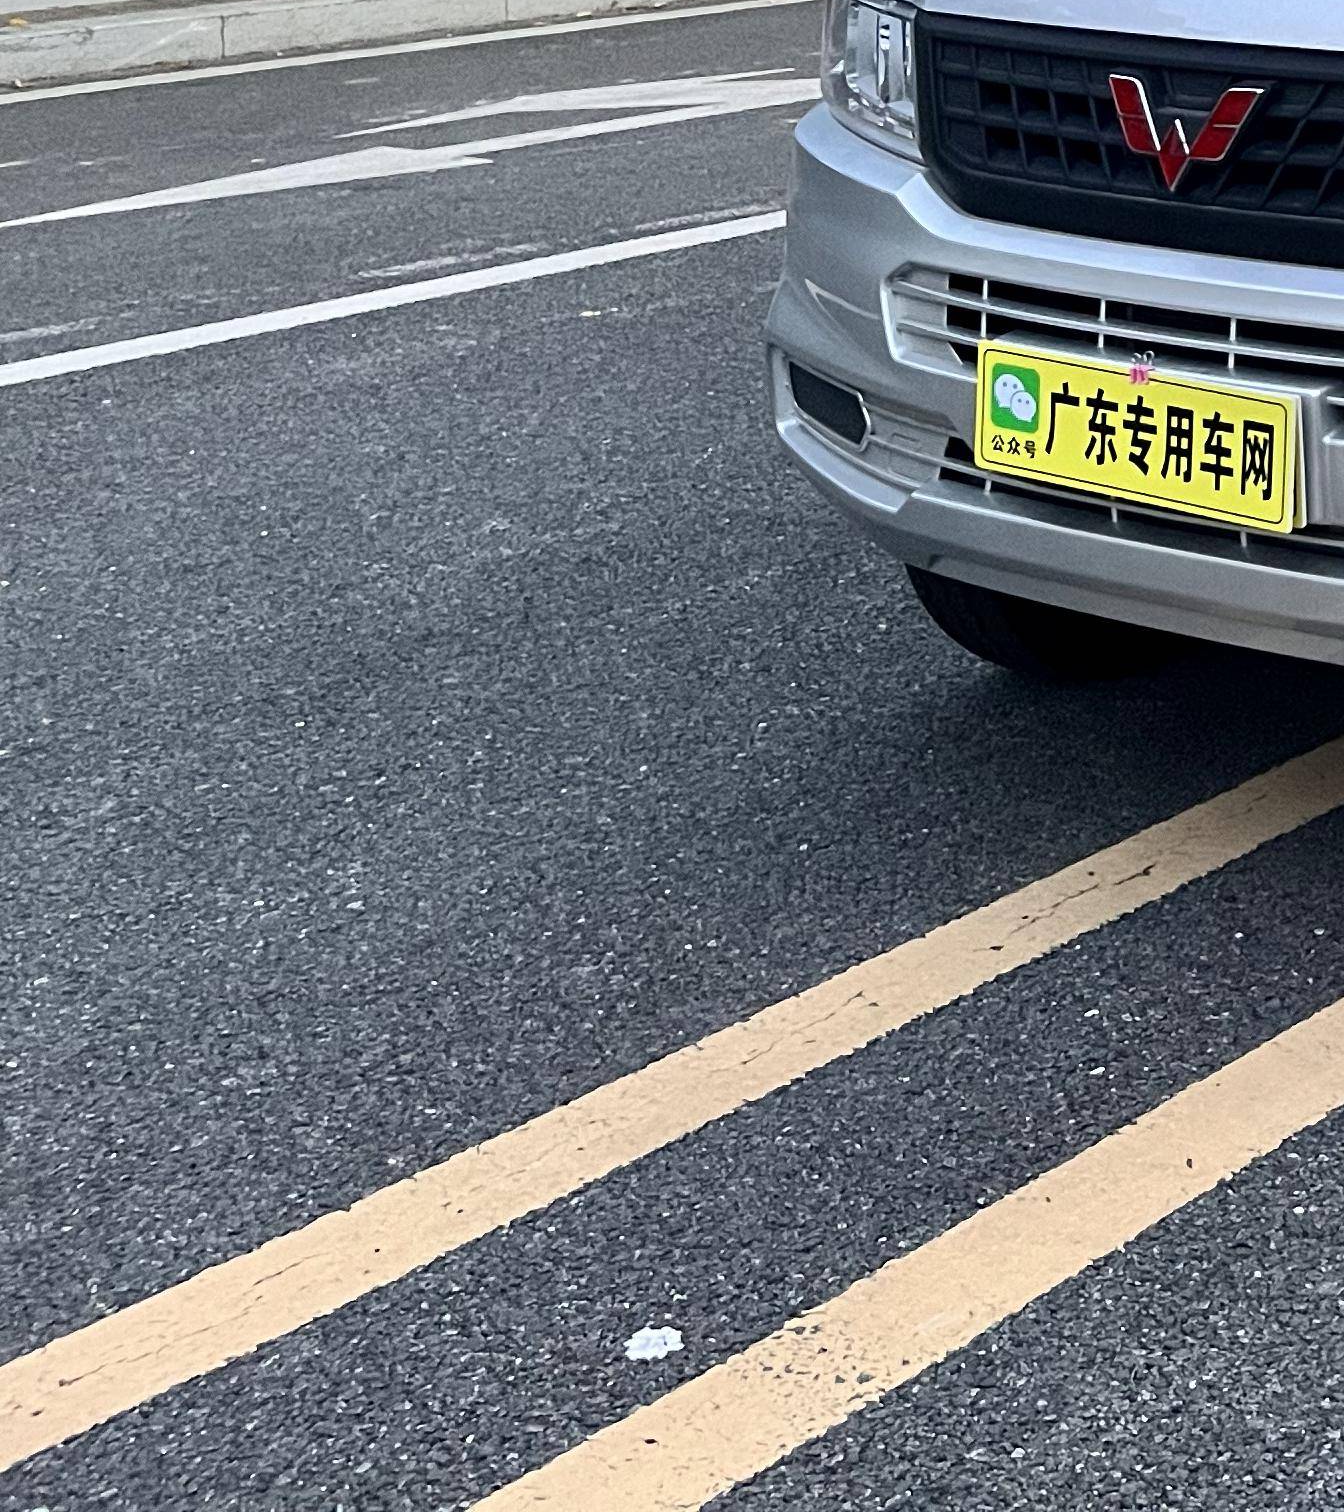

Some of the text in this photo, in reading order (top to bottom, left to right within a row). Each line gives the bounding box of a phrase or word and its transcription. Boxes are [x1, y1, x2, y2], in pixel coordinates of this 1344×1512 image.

[990, 434, 1037, 459] 公众号
[1044, 381, 1275, 501] 广东专用车网
